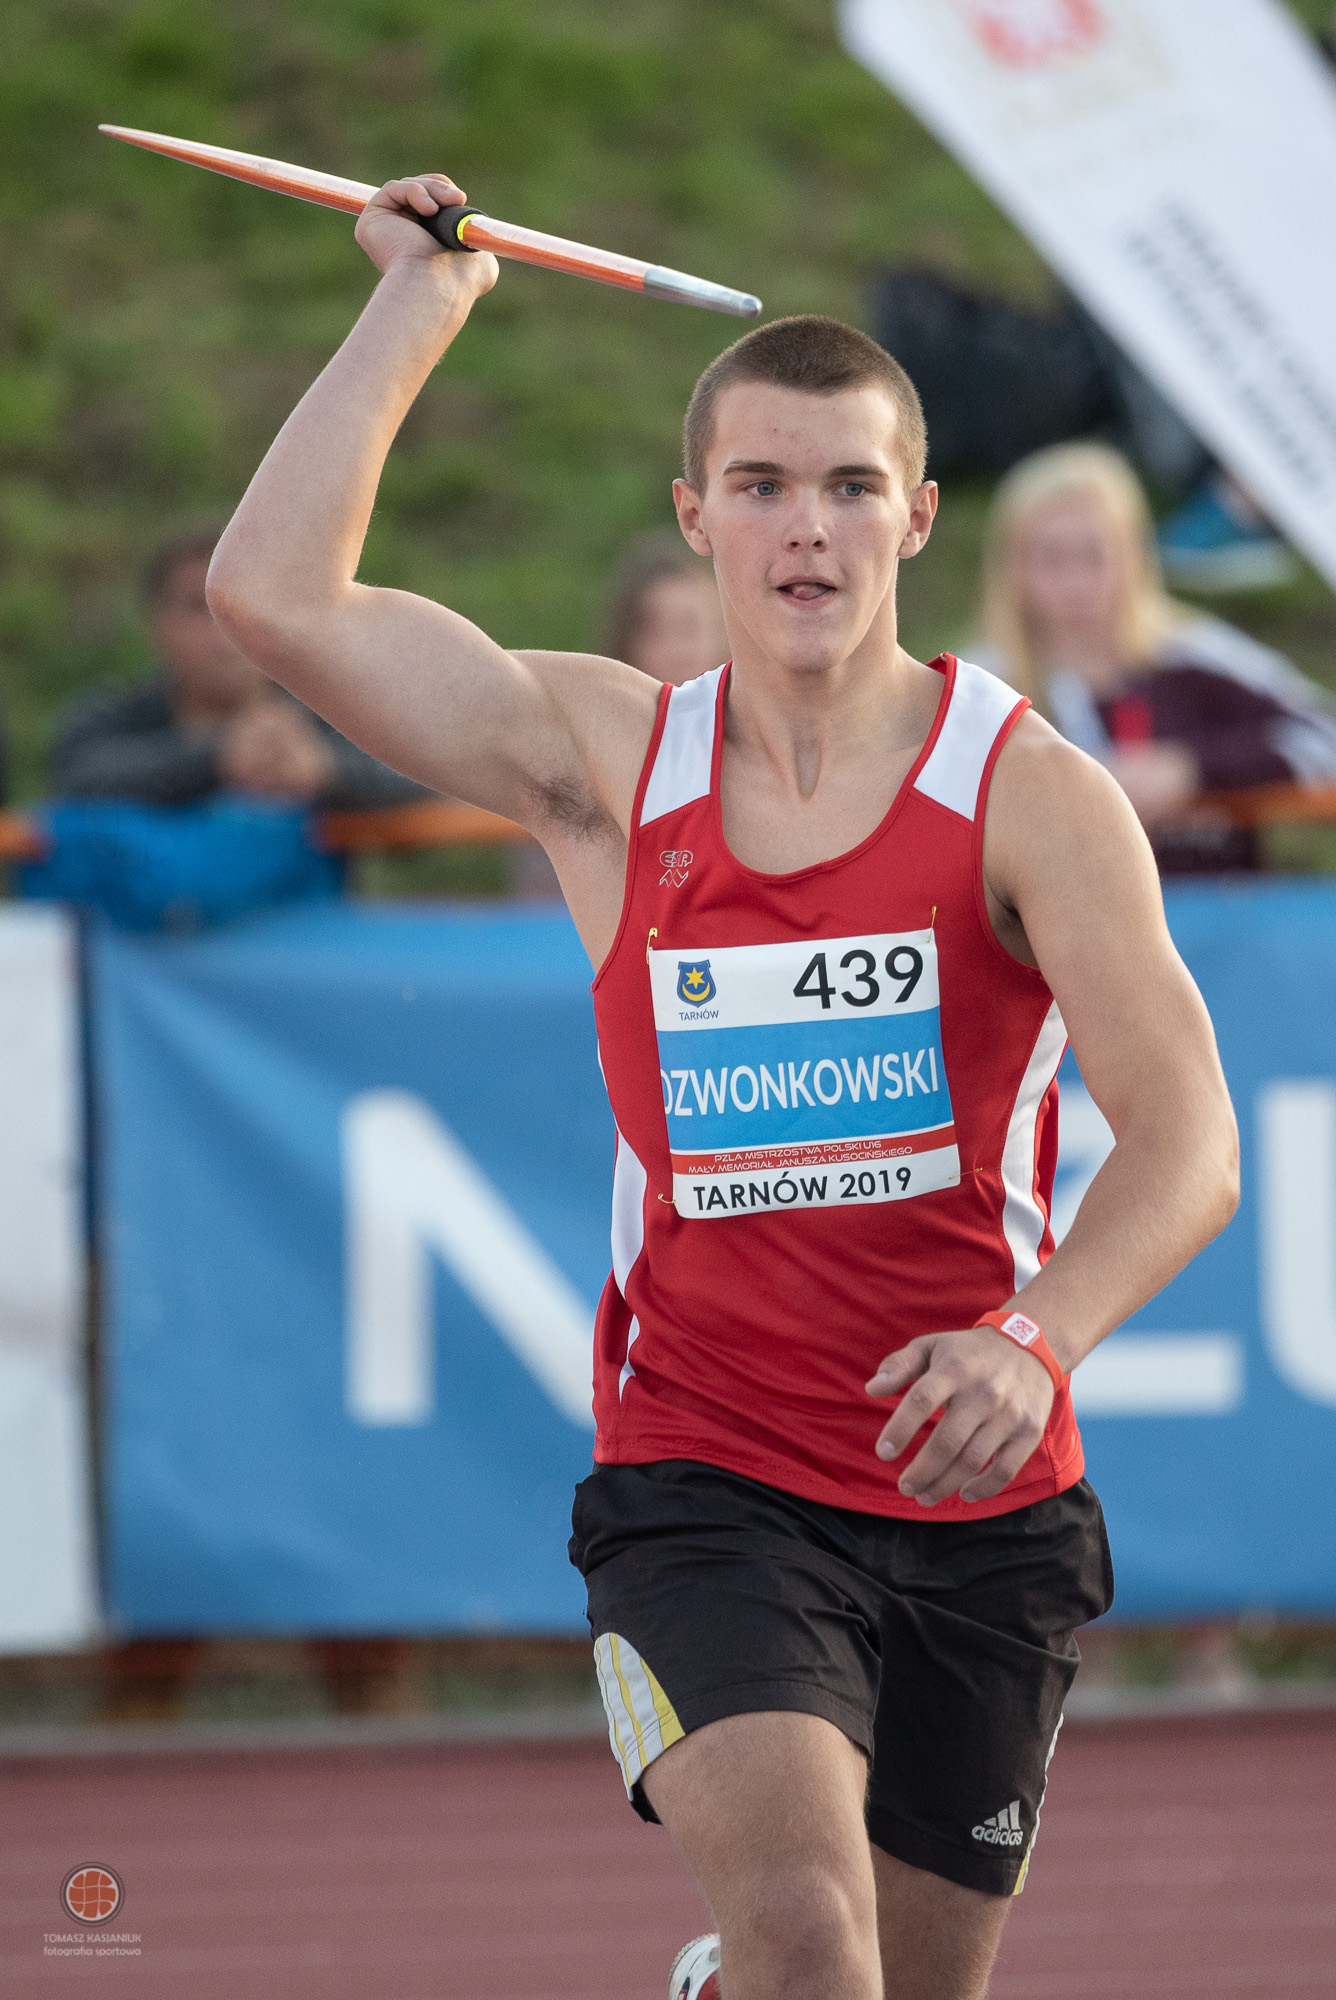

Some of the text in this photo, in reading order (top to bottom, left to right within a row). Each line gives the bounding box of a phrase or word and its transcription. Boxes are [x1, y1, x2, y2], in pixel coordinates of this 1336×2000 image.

[793, 945, 924, 1009] 439
[678, 1009, 720, 1021] TARNÓW
[688, 1146, 912, 1174] MAŁY MEMORIAŁ JANUSZA KUSOCIŃSKIEGO
[714, 1141, 882, 1162] PZLA MISTRZOSTWA POLSKI U16
[693, 1167, 911, 1210] TARNÓW 2019
[971, 1825, 1023, 1846] adidas
